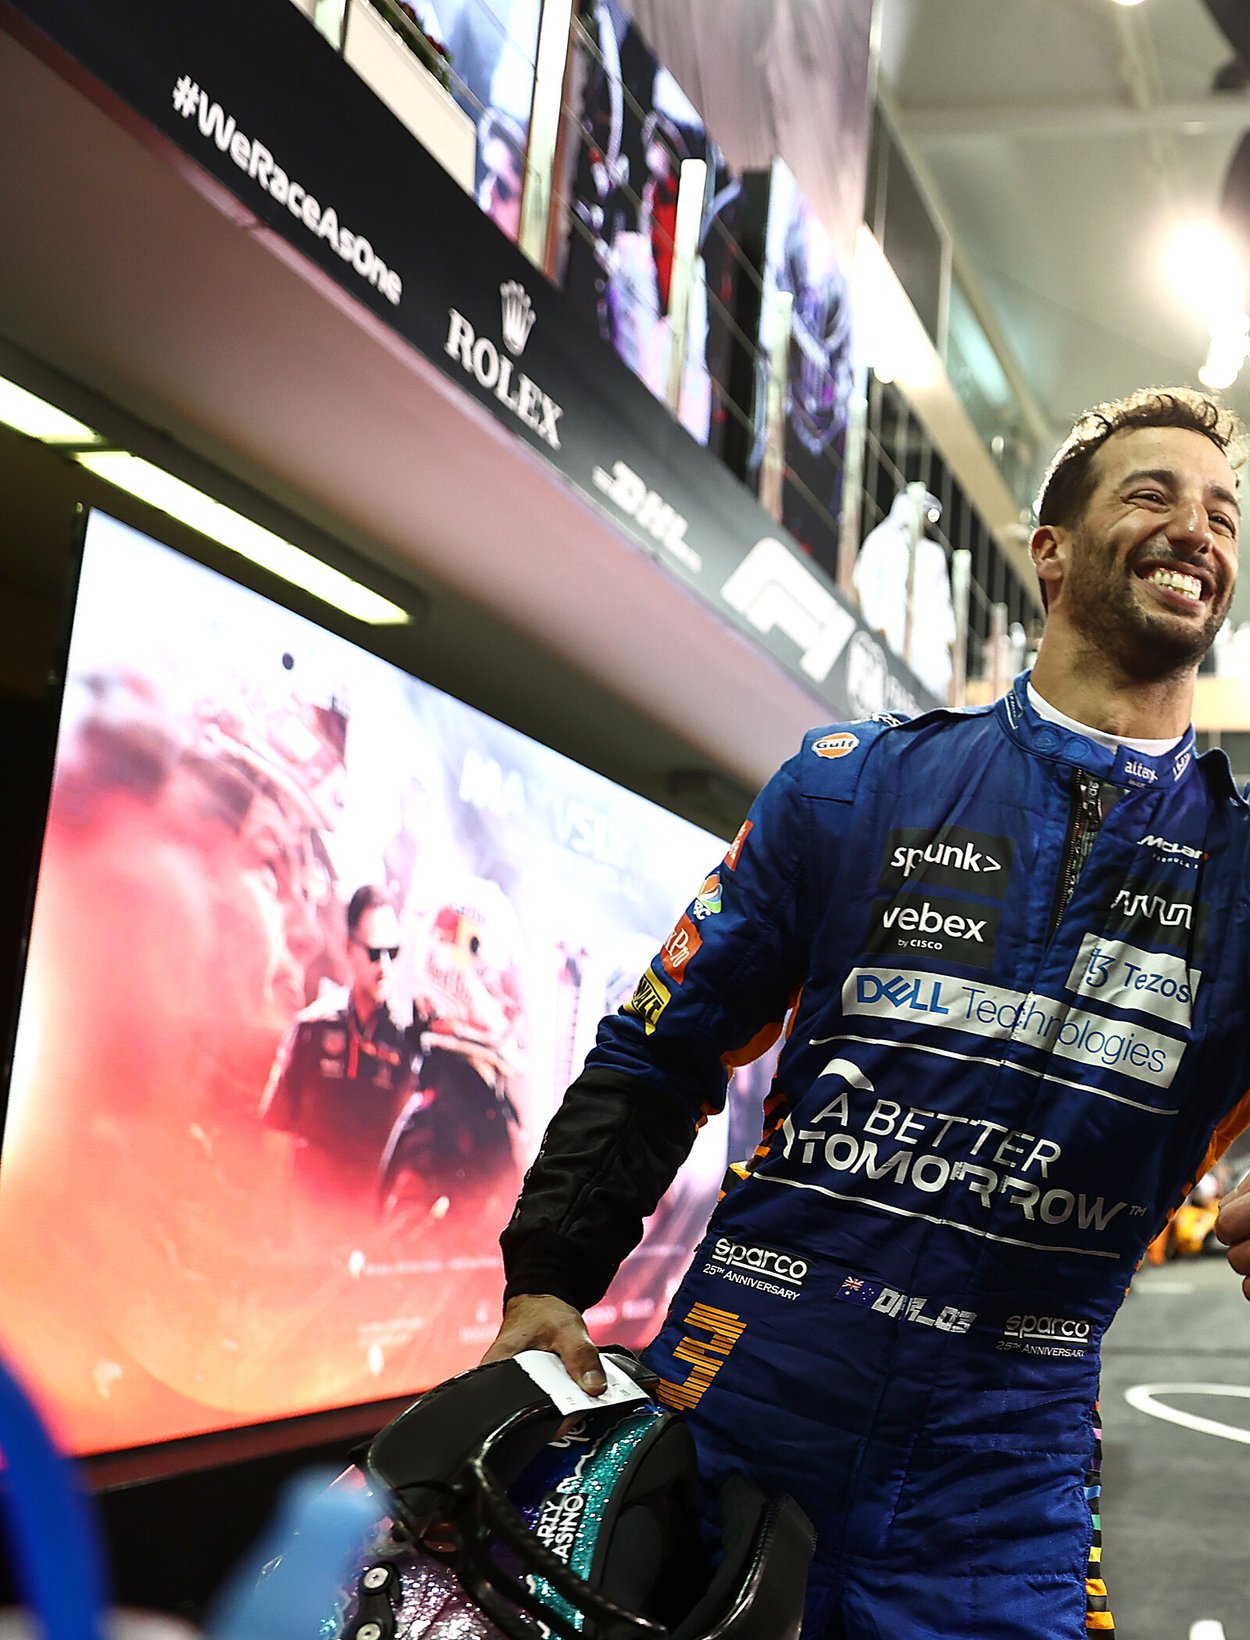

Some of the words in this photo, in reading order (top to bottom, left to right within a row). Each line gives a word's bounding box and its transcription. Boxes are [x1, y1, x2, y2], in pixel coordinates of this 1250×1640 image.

[172, 75, 402, 304] #WeRaceAsOne
[443, 307, 564, 450] ROLEX
[600, 461, 694, 560] DHL
[815, 739, 856, 750] Gulf
[890, 842, 1002, 877] spunk>
[1137, 835, 1203, 858] McLar
[910, 938, 943, 951] CISCO
[1123, 961, 1191, 1003] Tezos
[856, 975, 949, 1015] DELL
[961, 986, 1167, 1073] Technologies
[811, 1093, 849, 1126] A
[863, 1098, 1062, 1178] BETTER
[799, 1129, 1128, 1231] TOMORROW
[713, 1237, 808, 1280] sparco
[723, 1270, 801, 1301] ANNIVERSARY
[1005, 1313, 1091, 1340] sparco
[1021, 1343, 1087, 1358] ANNIVERSARY
[551, 1495, 584, 1562] ASINO
